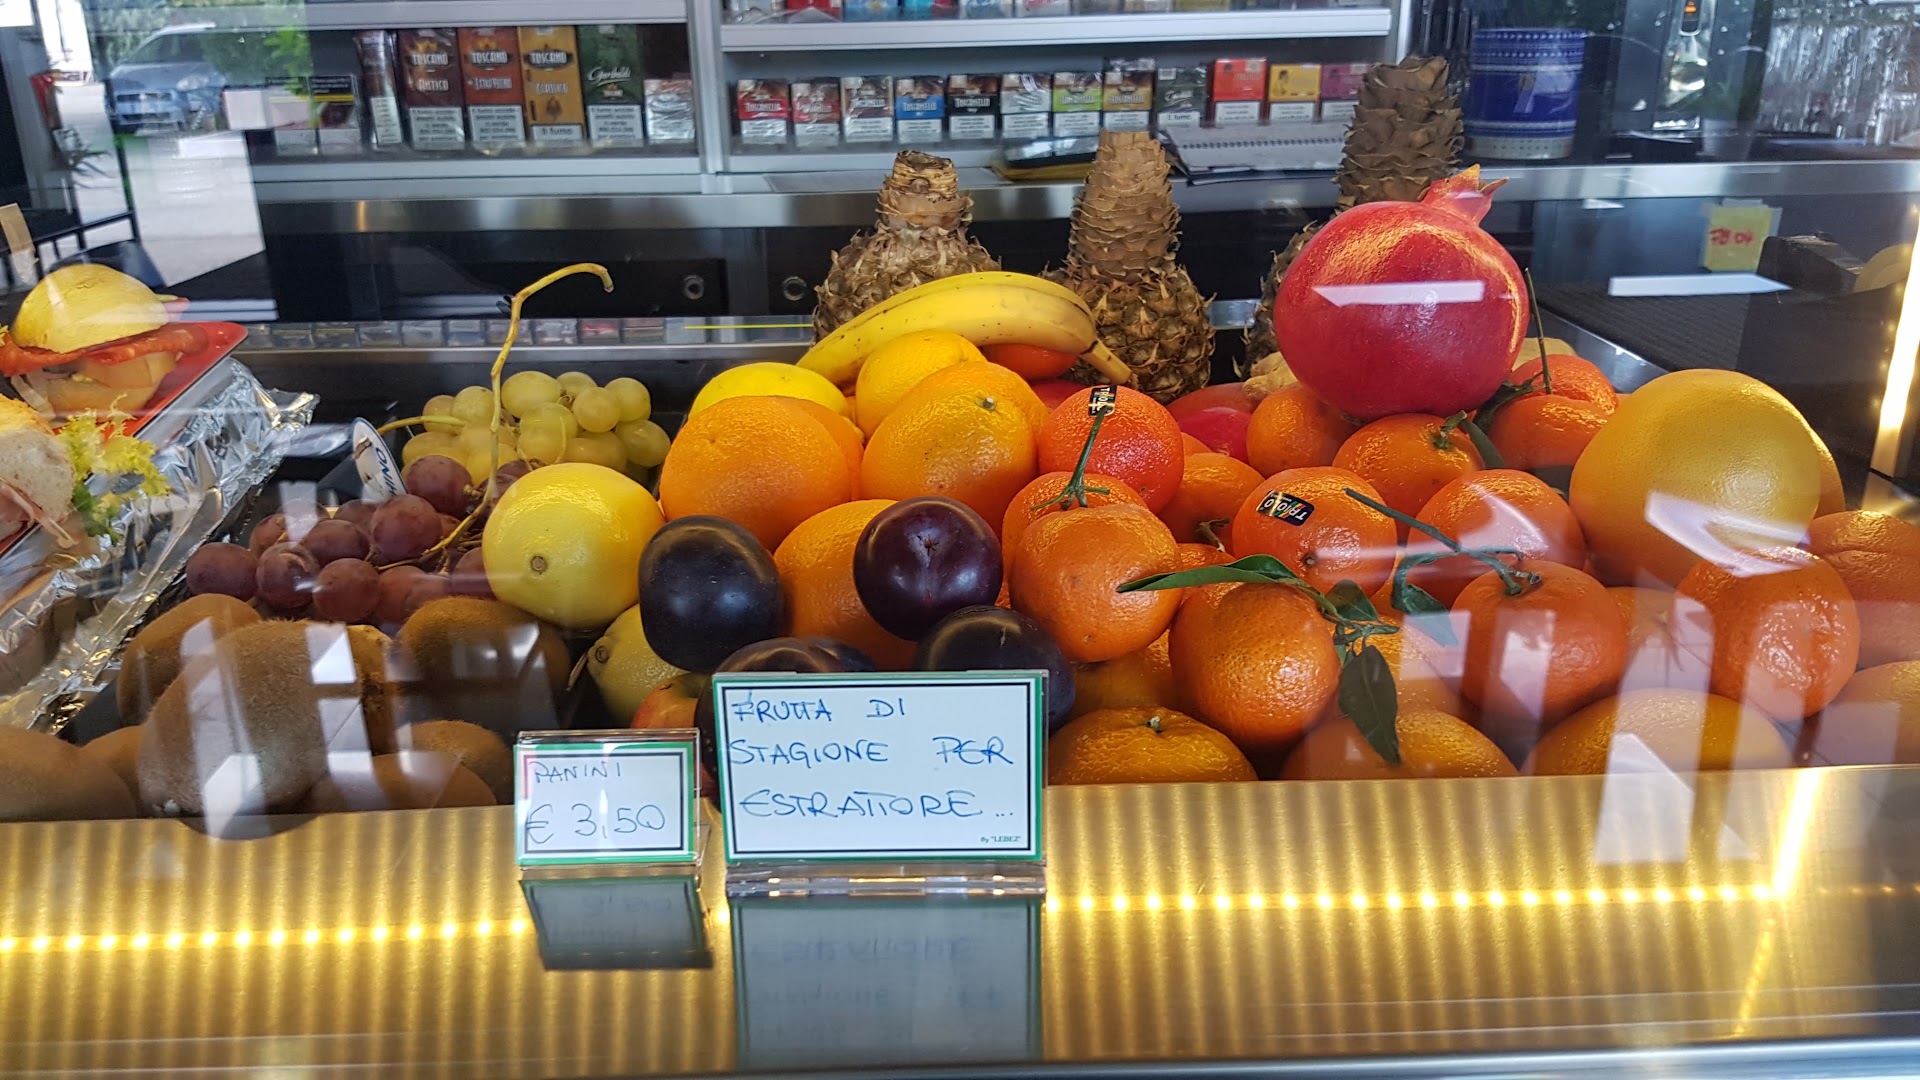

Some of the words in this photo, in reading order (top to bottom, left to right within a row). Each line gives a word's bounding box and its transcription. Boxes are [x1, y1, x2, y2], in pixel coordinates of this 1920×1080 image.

[411, 53, 449, 66] TOSCANO
[471, 51, 508, 64] TOSCANO
[530, 51, 567, 64] TOSCANO
[732, 691, 833, 723] FRUTTA
[866, 698, 906, 717] DI
[728, 739, 889, 769] STAGIONE
[932, 736, 1015, 765] PER
[529, 761, 622, 784] PANINI
[526, 803, 555, 844] €
[571, 803, 666, 839] 3,50
